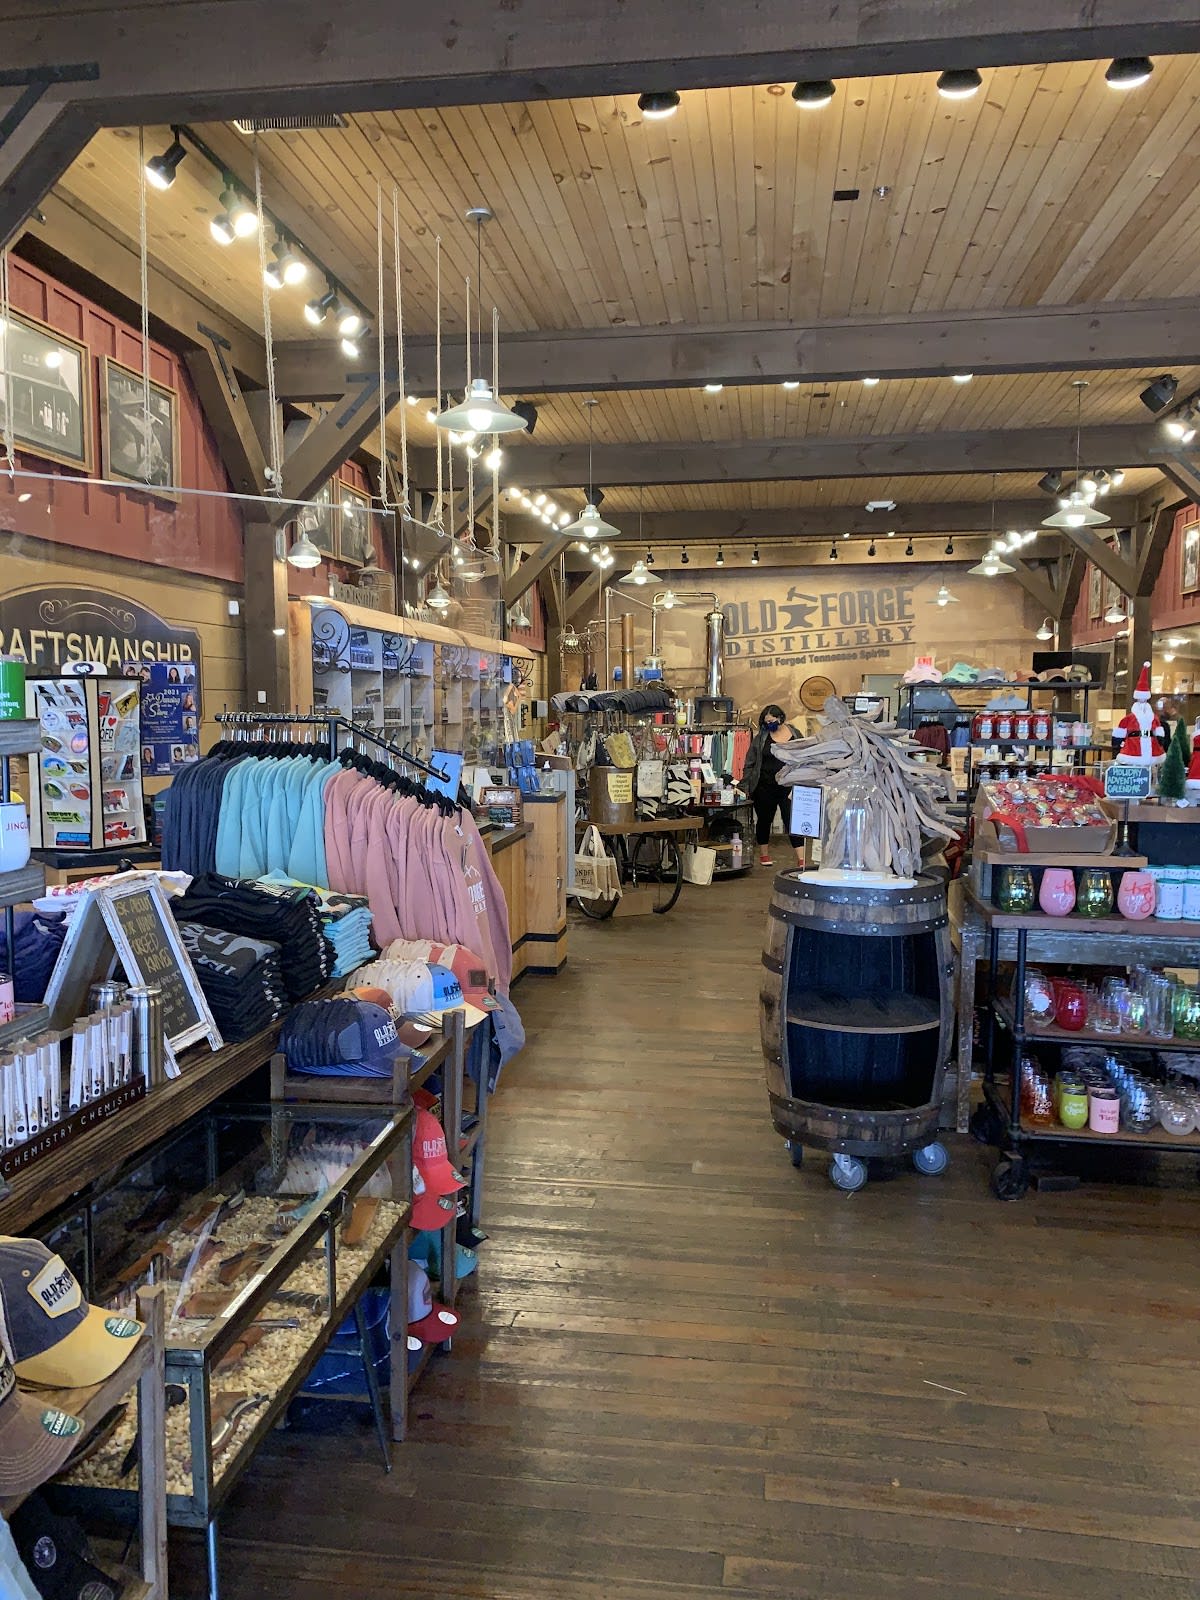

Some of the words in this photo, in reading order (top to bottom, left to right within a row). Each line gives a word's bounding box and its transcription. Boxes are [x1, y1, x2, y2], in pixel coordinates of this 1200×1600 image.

[722, 599, 777, 636] OLD
[819, 586, 916, 628] FORGE
[0, 628, 192, 668] AFTSMANSHIP
[725, 624, 916, 657] DISTILLERY
[750, 657, 772, 669] Hand
[775, 655, 806, 667] Forged
[80, 1085, 143, 1125] CHEMISTRY
[4, 1123, 73, 1172] CHEMISTRY
[41, 1283, 58, 1301] OLD
